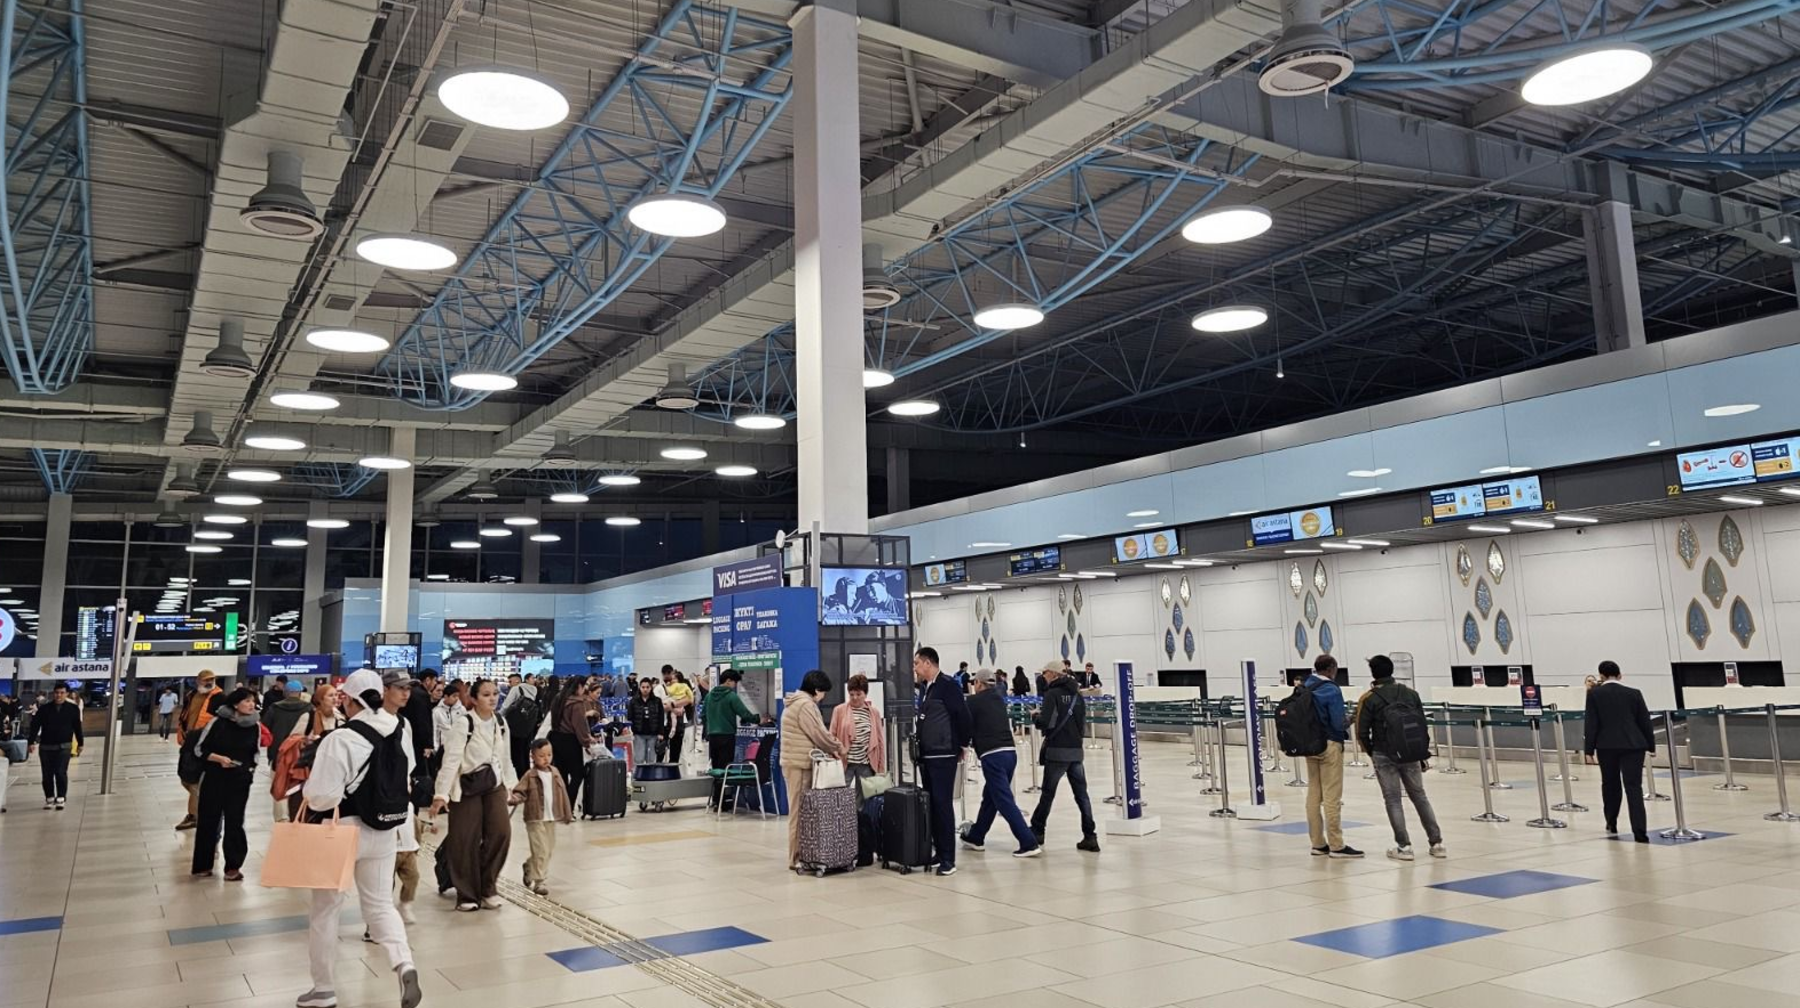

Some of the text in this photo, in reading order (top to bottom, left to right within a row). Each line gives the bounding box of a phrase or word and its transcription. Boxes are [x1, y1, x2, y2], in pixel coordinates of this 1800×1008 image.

[1667, 485, 1680, 495] 22
[1545, 500, 1555, 510] 21
[1423, 516, 1432, 525] 20
[717, 570, 737, 589] VISA
[54, 663, 109, 672] air astana
[1126, 669, 1140, 790] BAGGAGE DROP-OFF
